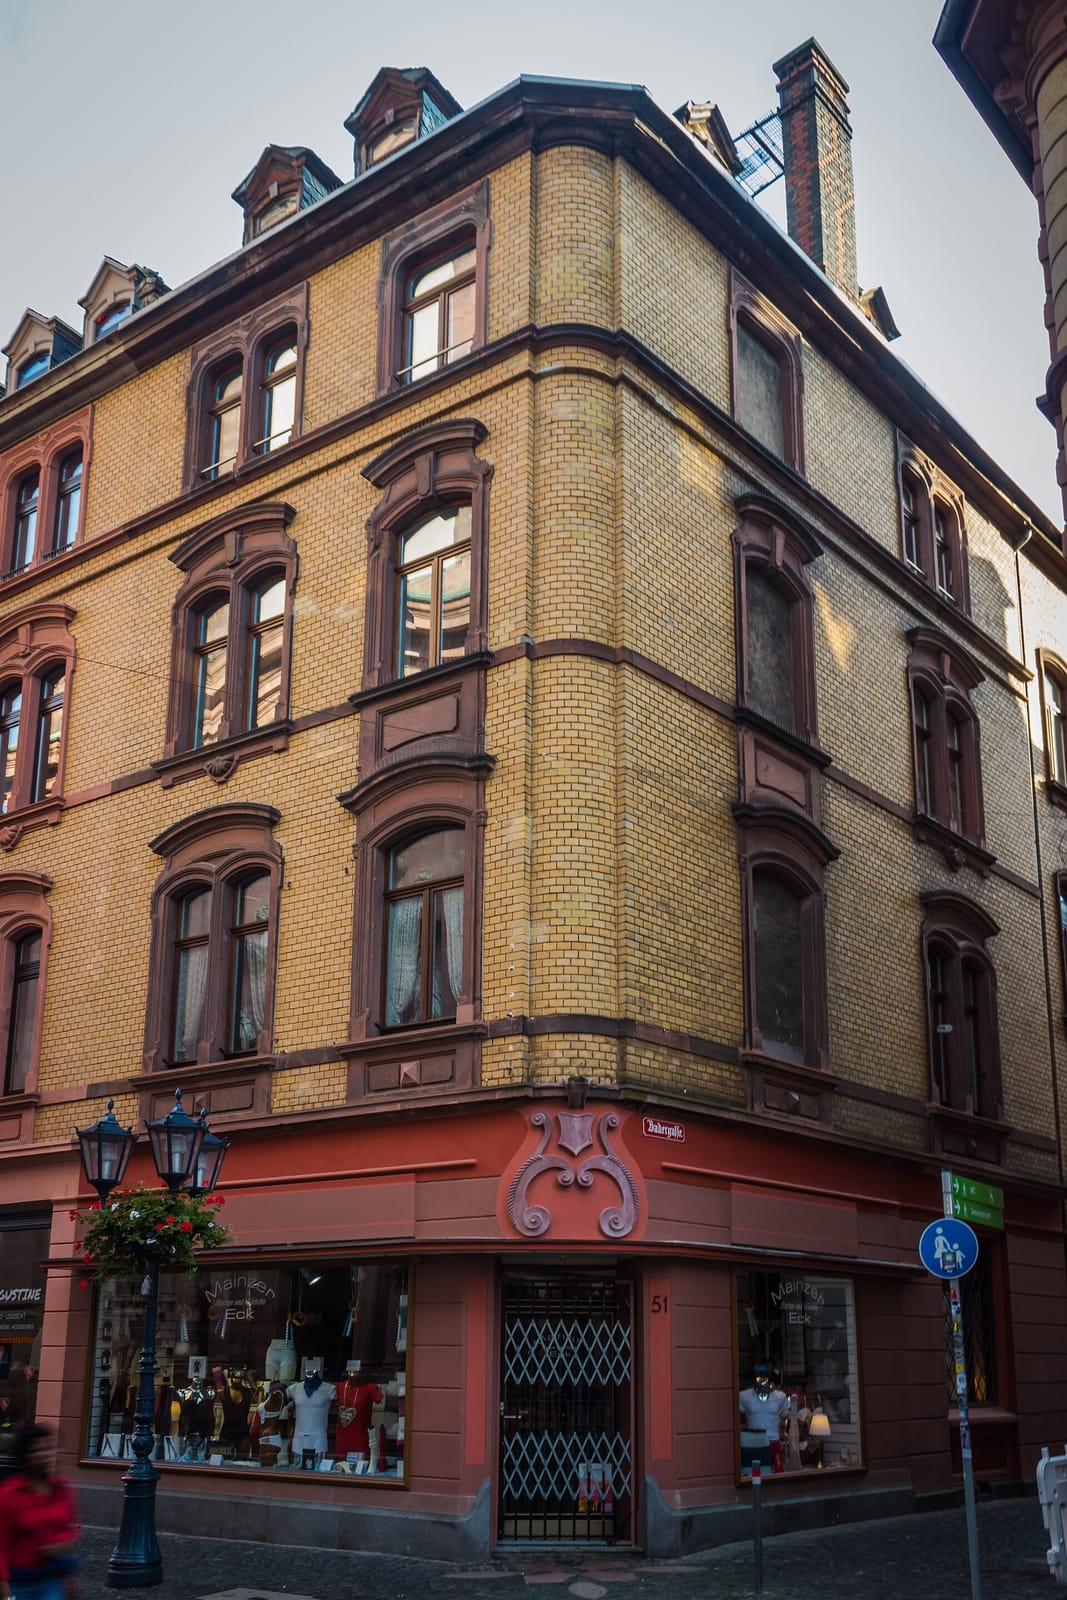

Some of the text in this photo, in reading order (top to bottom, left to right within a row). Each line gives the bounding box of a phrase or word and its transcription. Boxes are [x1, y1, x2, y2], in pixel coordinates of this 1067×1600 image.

[204, 1273, 276, 1303] Mainzer
[770, 1280, 825, 1306] Mainzer
[225, 1308, 255, 1320] Eck
[651, 1295, 668, 1314] 51
[789, 1311, 812, 1324] Eck
